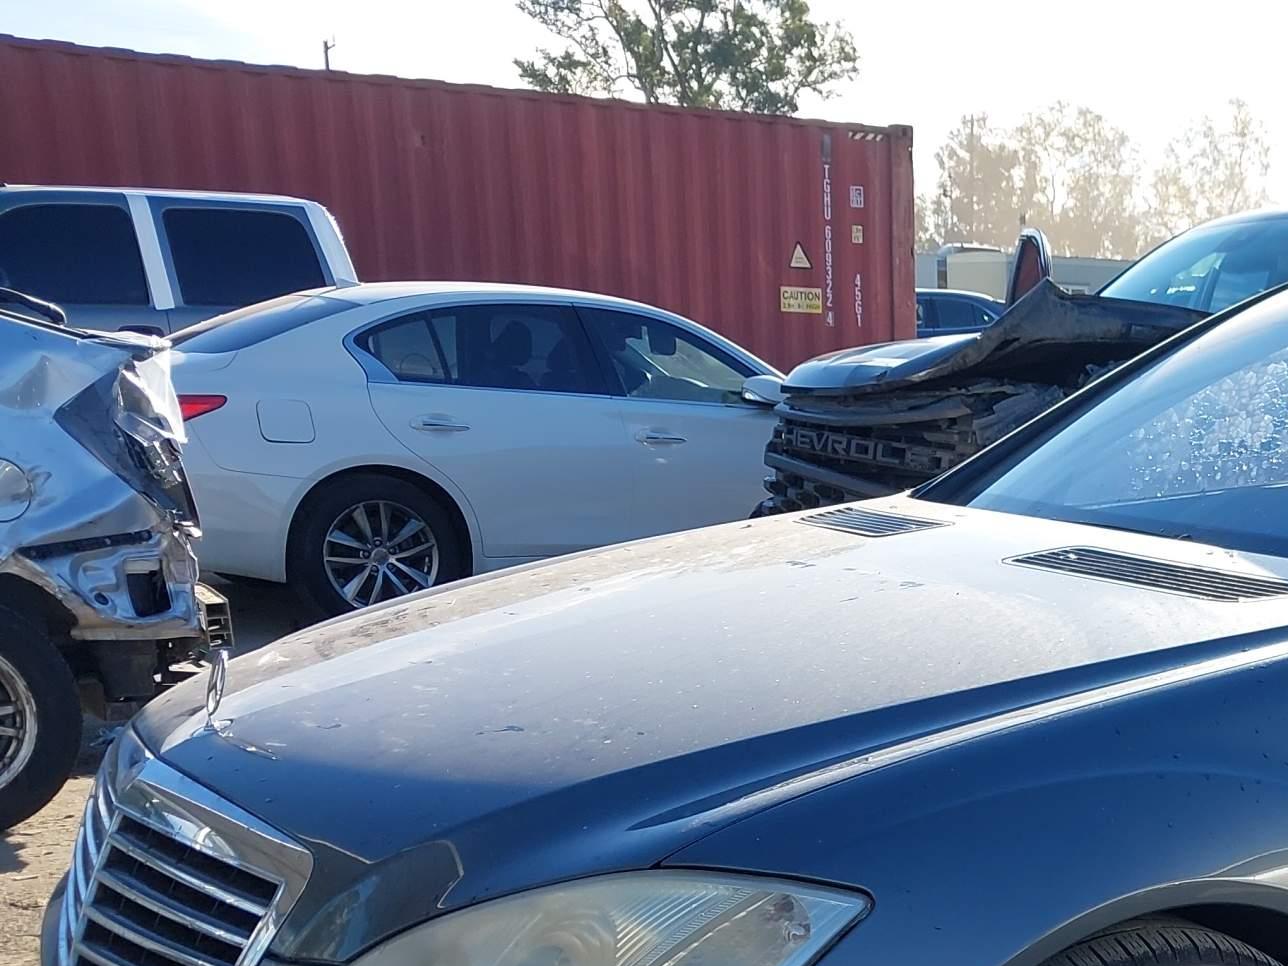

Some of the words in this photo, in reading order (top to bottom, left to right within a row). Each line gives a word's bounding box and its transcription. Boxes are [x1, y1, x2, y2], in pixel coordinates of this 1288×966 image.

[823, 164, 832, 221] TGHU
[783, 290, 821, 302] CAUTION
[854, 273, 863, 328] 45G1
